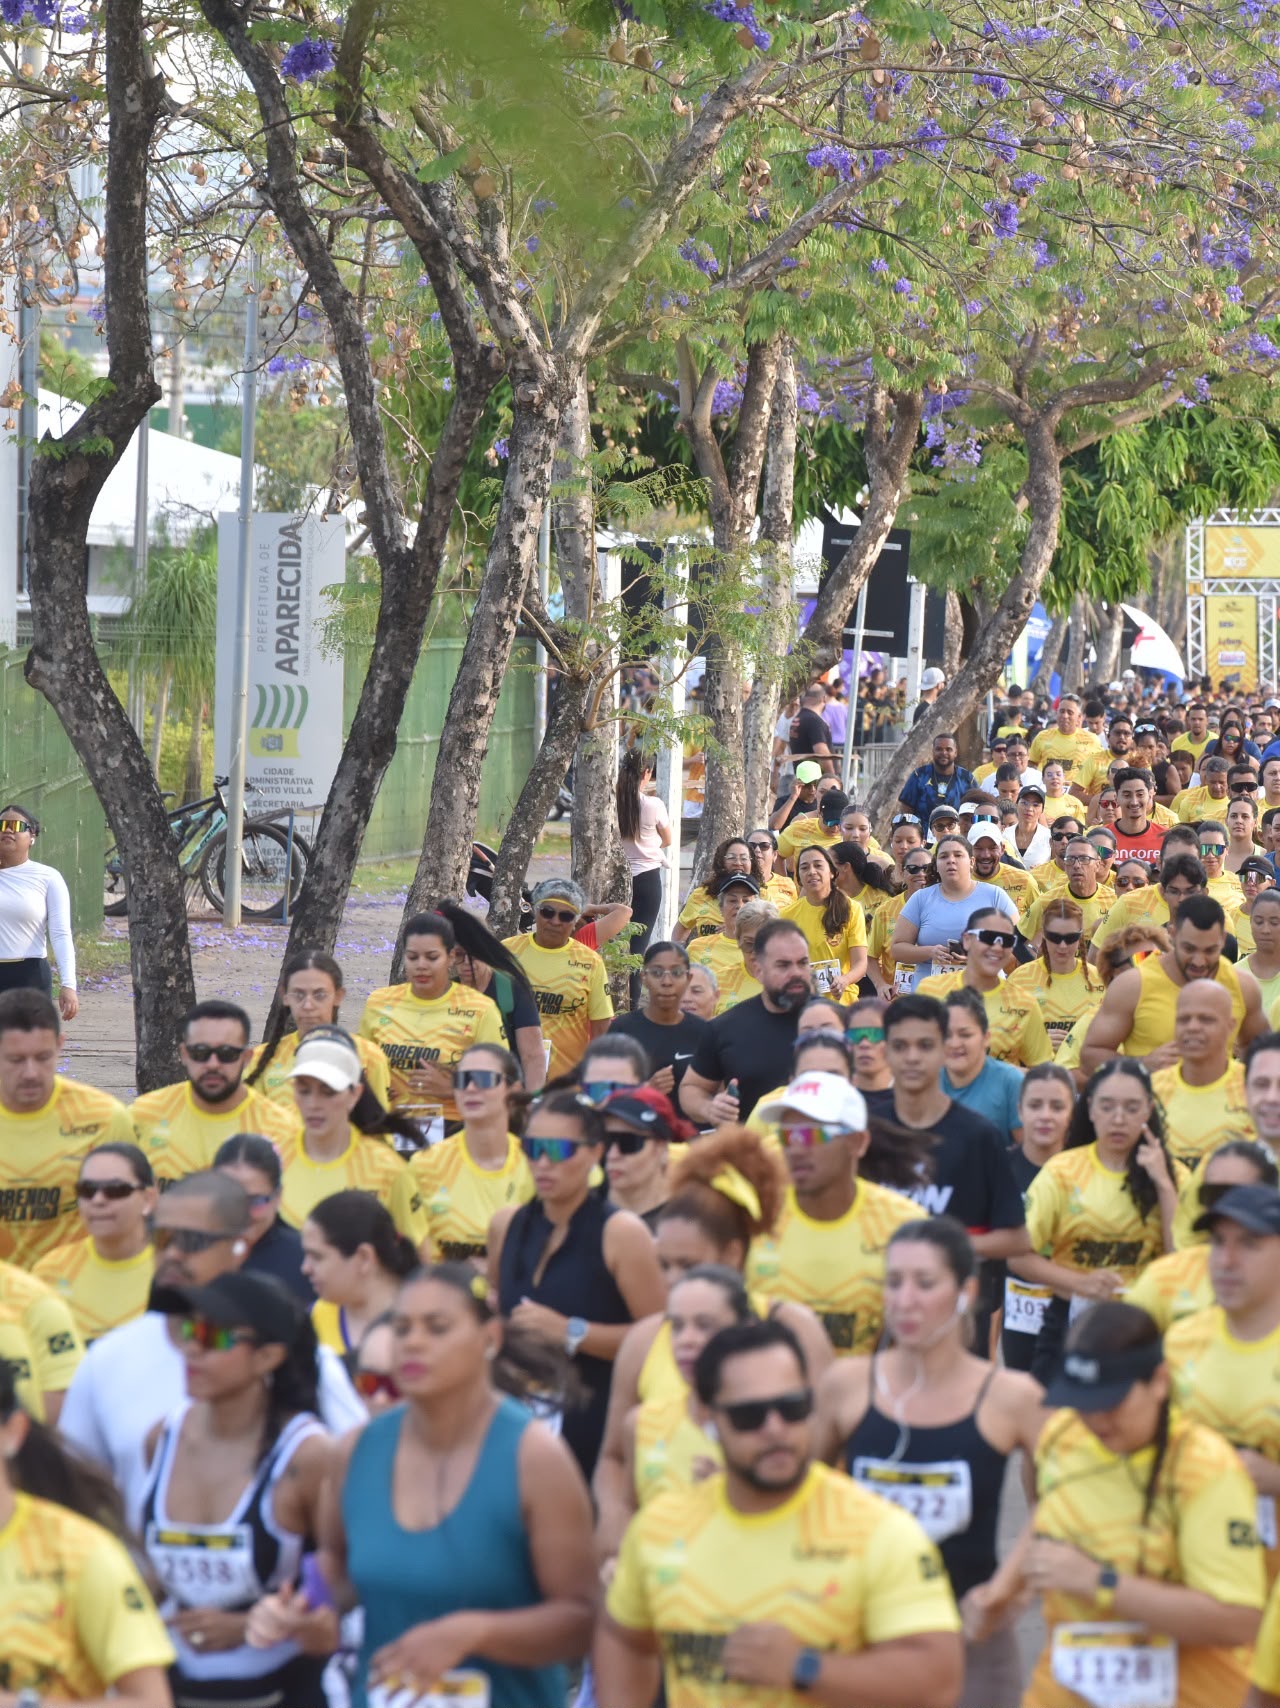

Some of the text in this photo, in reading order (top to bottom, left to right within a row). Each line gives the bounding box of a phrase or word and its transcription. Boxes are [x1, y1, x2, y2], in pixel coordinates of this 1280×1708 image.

[256, 543, 270, 652] PREFEITURA DE
[274, 522, 302, 676] APARECIDA
